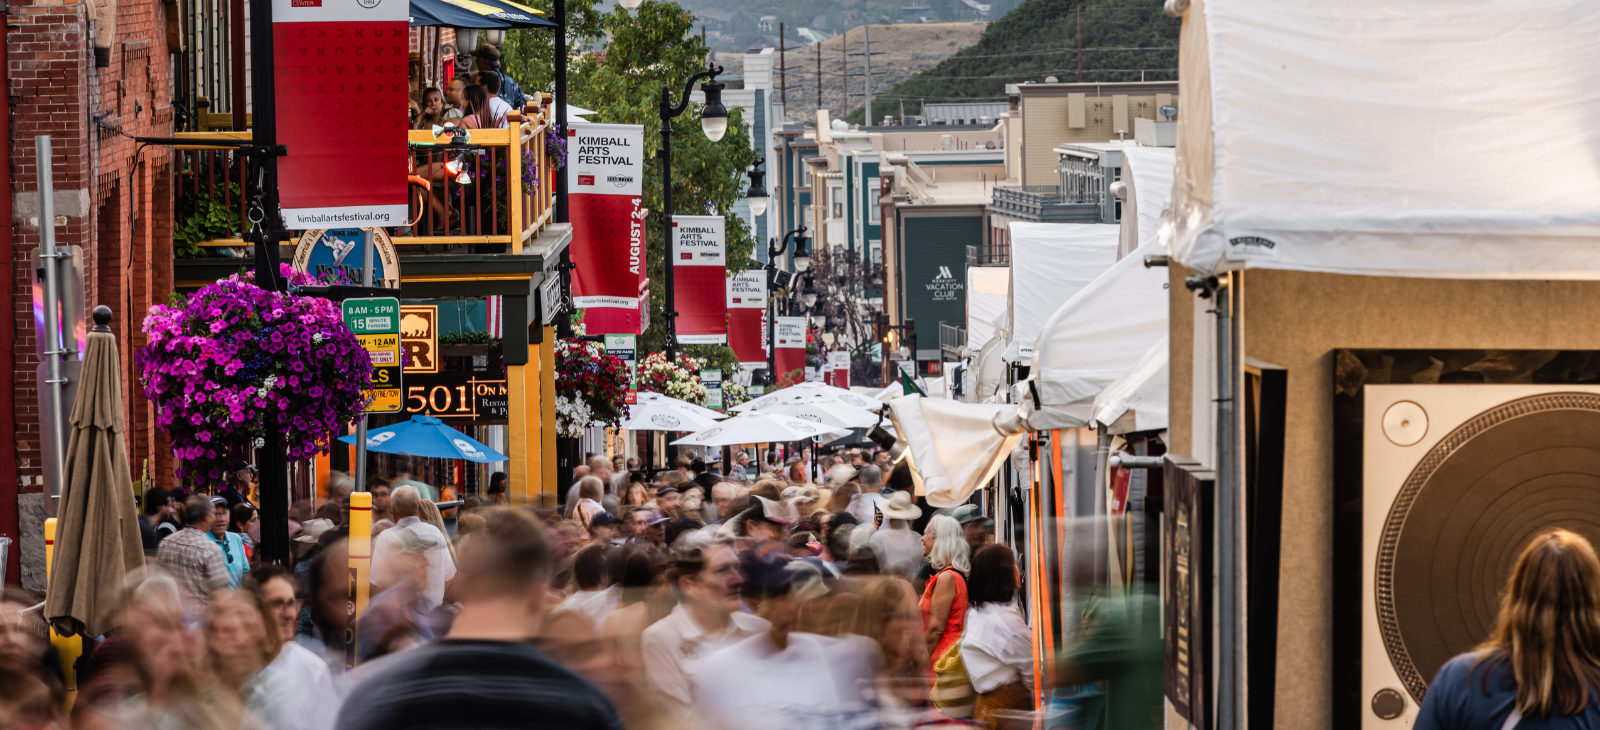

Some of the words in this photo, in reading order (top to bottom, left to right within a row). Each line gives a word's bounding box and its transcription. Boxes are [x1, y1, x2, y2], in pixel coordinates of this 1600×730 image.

[578, 136, 631, 147] KIMBALL
[578, 146, 610, 156] ARTS
[578, 155, 634, 166] FESTIVAL
[631, 198, 642, 219] 2-4
[297, 212, 390, 223] kimballartsfestival.org
[629, 220, 641, 275] AUGUST
[925, 283, 964, 291] VACATION
[934, 290, 955, 298] CLUB
[348, 306, 354, 314] 8
[355, 306, 368, 314] AM
[374, 306, 380, 314] 5
[381, 305, 394, 314] PM
[352, 318, 365, 330] 15
[373, 338, 382, 346] 12
[384, 338, 396, 346] AM
[476, 383, 496, 396] ON
[406, 385, 471, 412] 501
[491, 407, 497, 415] &
